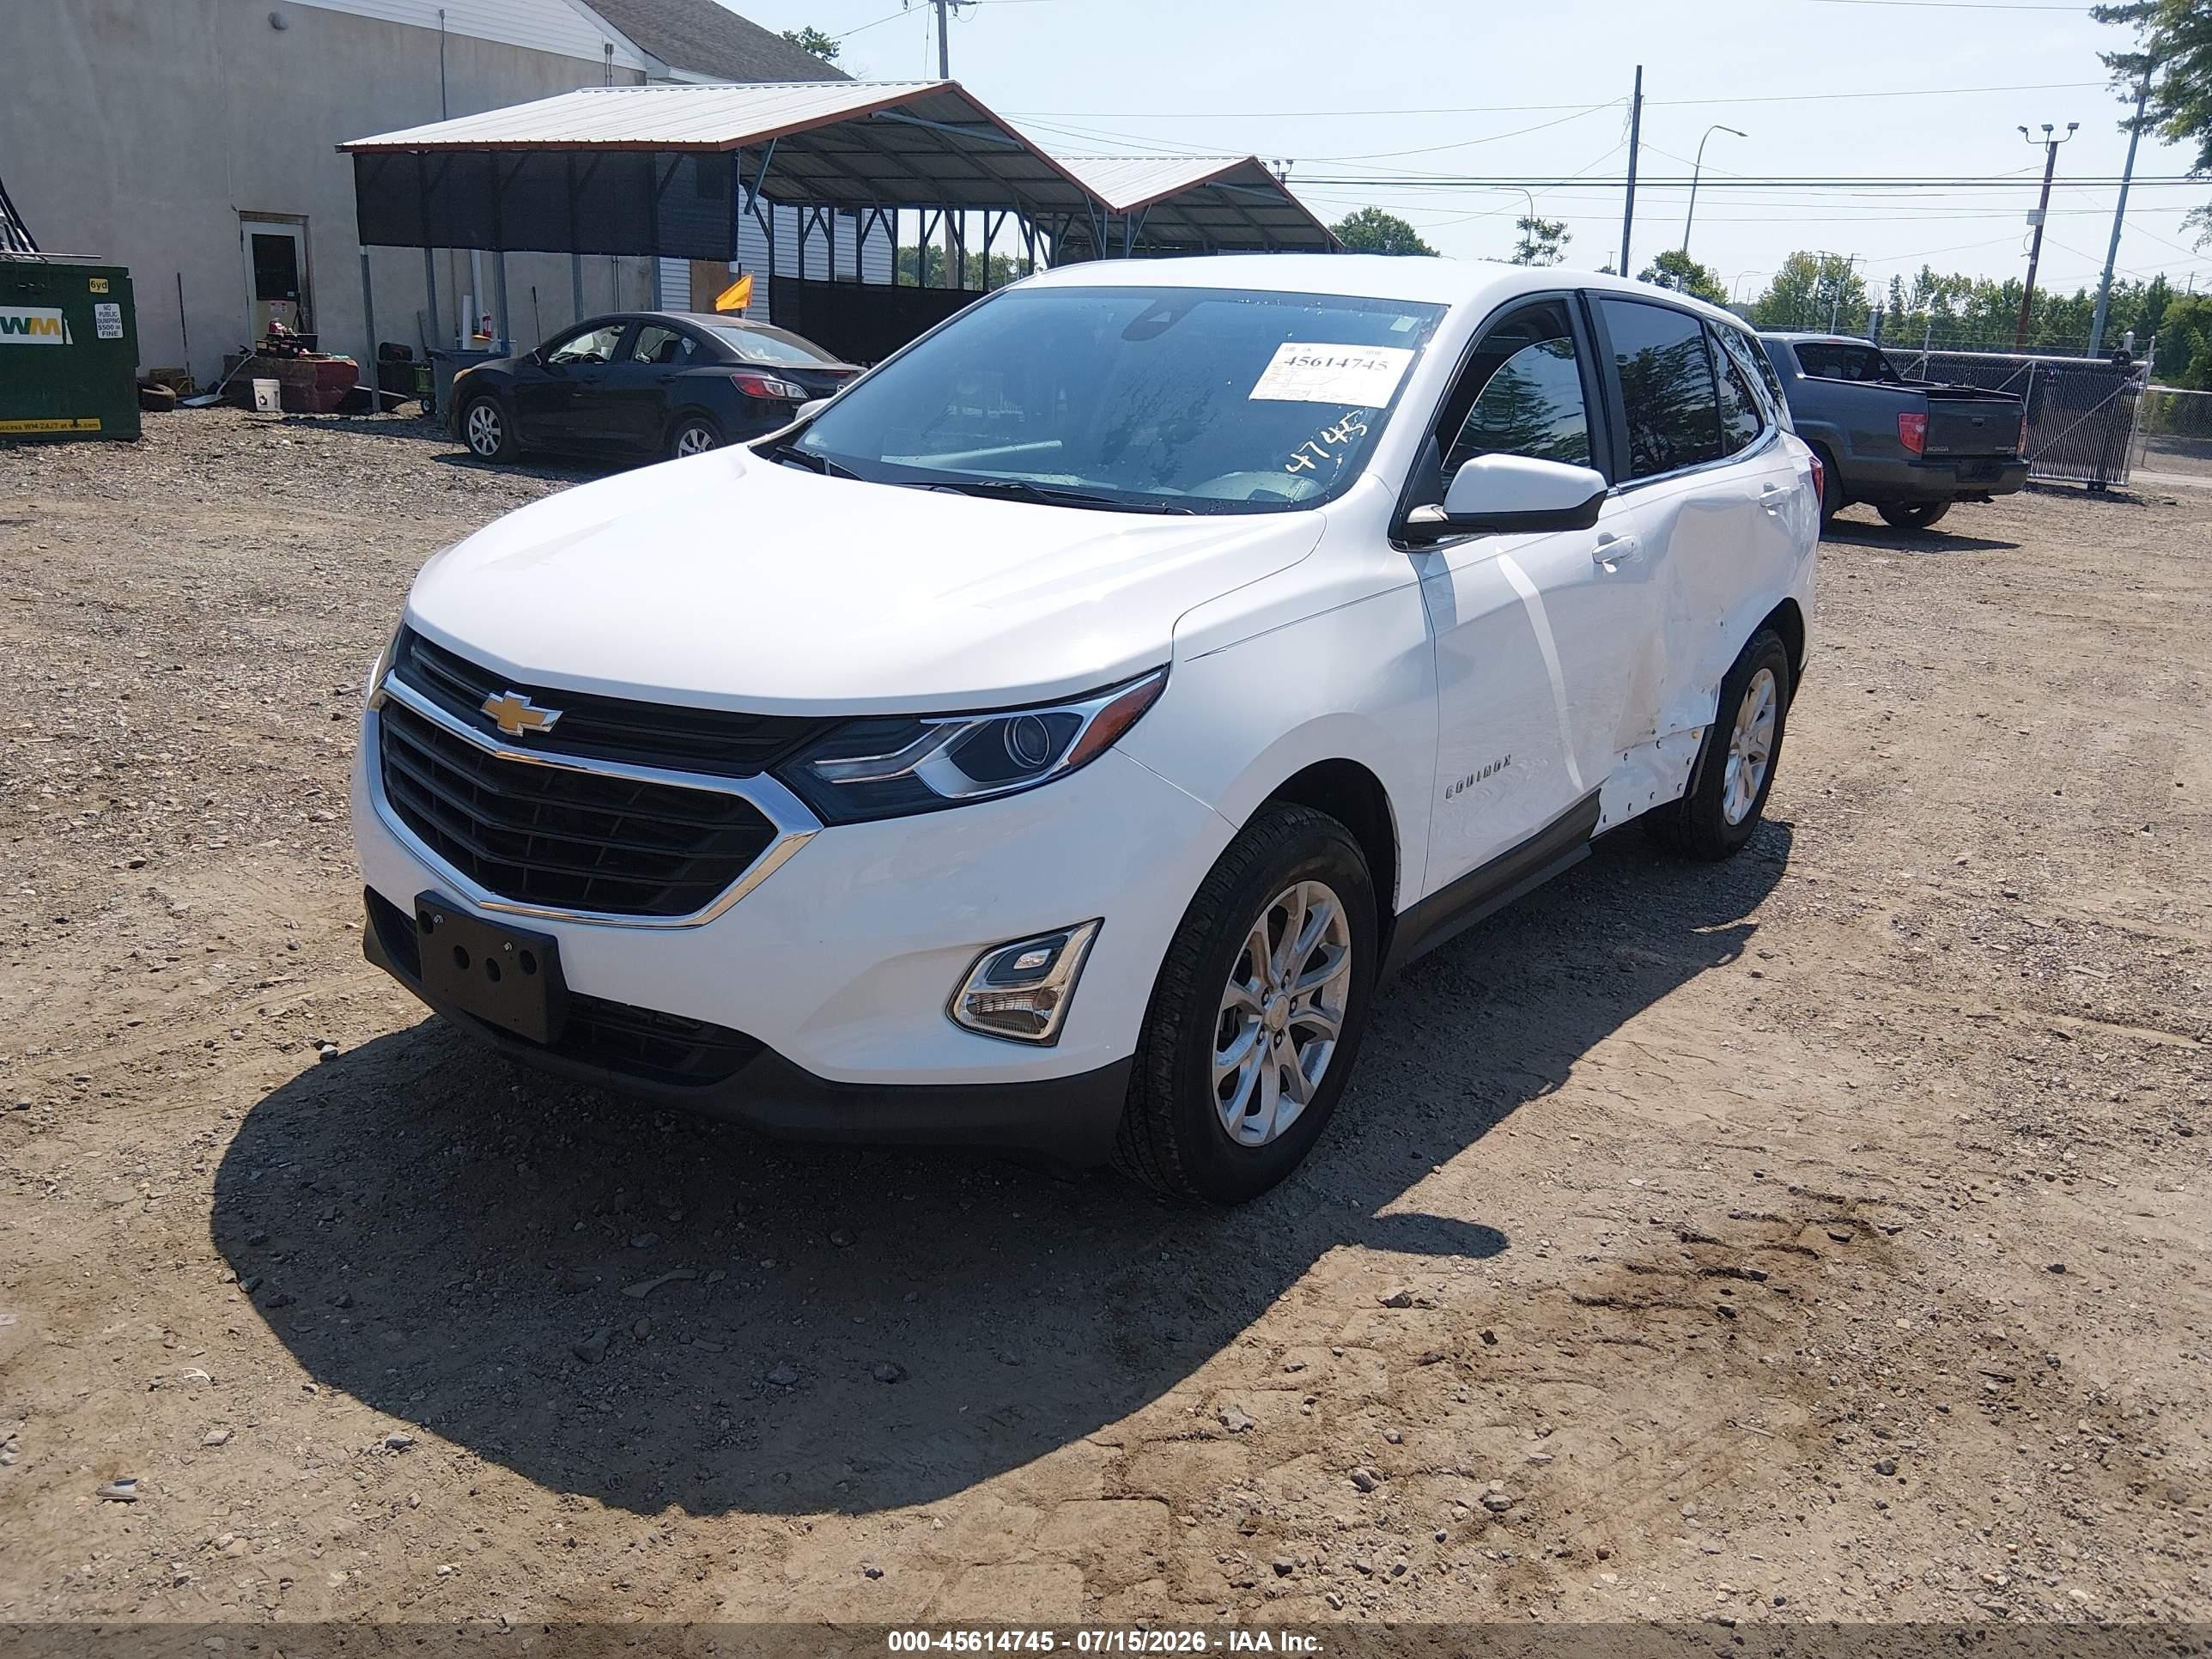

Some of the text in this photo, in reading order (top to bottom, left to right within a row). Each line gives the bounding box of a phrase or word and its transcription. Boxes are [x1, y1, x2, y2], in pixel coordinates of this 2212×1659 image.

[90, 280, 107, 290] 6yd
[0, 316, 61, 336] WM
[1283, 356, 1389, 372] 45614745
[1285, 408, 1368, 472] 4745
[1445, 753, 1511, 799] EQUINOX
